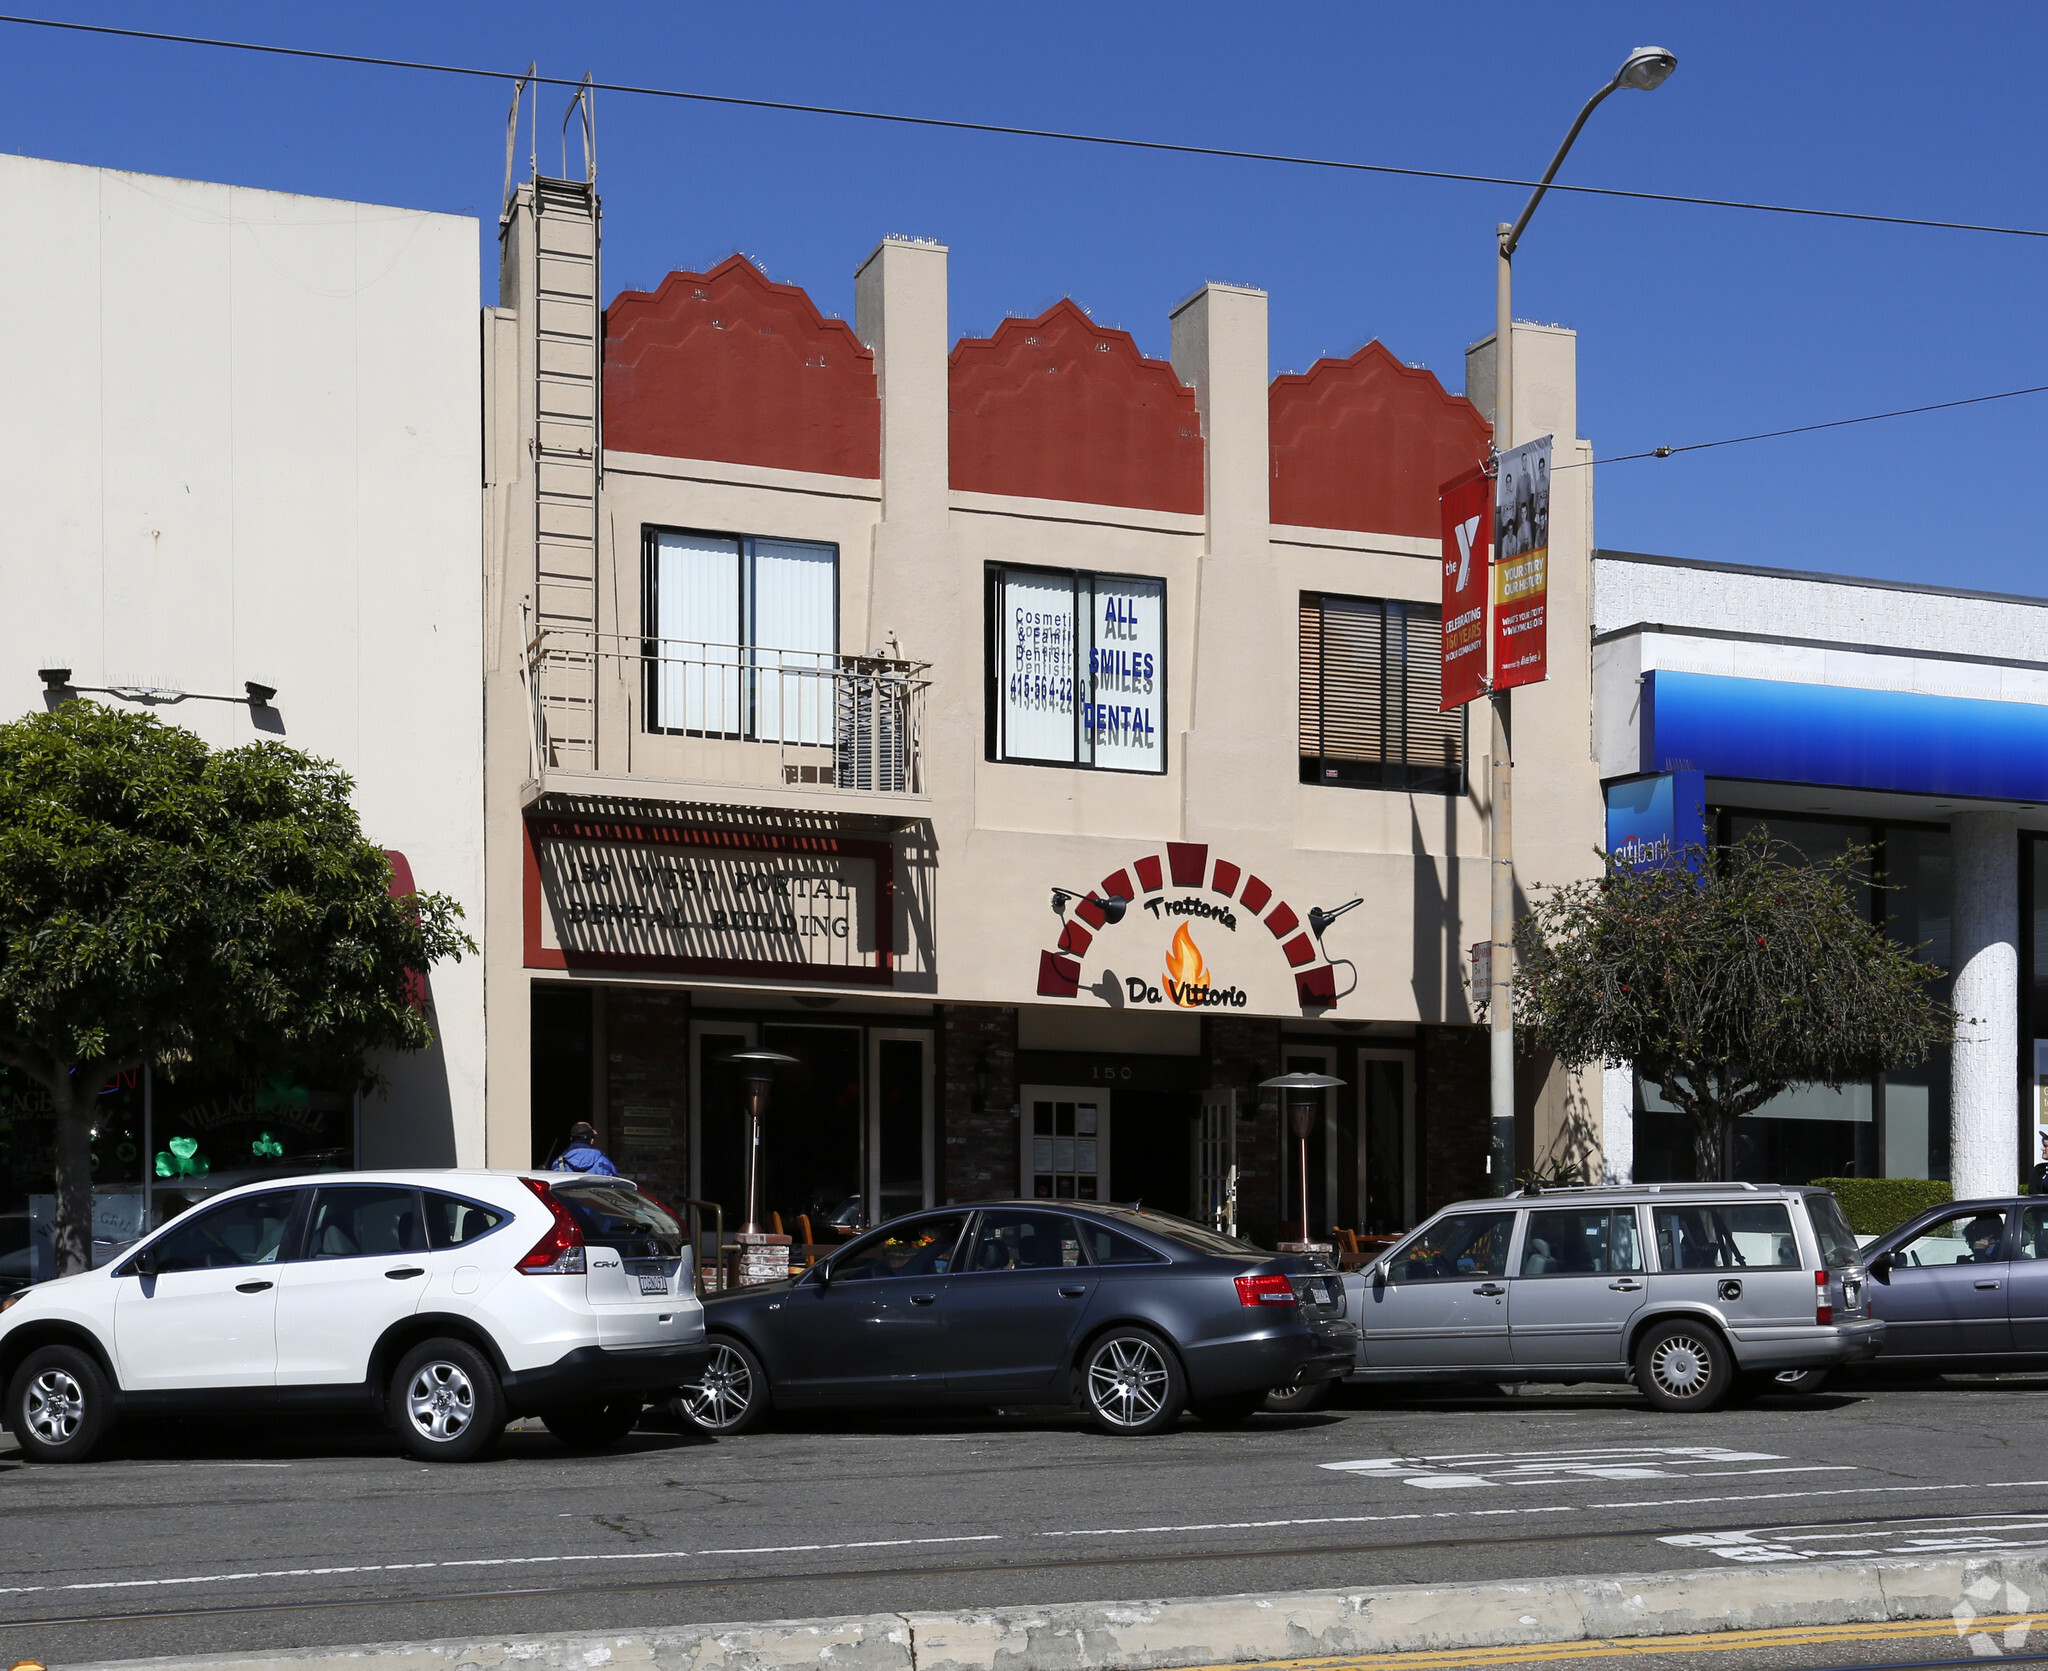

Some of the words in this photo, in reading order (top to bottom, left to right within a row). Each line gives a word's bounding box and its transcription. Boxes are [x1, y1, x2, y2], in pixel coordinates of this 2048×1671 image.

[1446, 560, 1457, 576] the
[1504, 565, 1523, 581] YOUR
[1504, 580, 1518, 595] OUR
[1016, 607, 1072, 627] Cosmeti
[1105, 597, 1138, 624] ALL
[1446, 606, 1481, 634] CELEBRATING
[1018, 626, 1025, 641] &
[1033, 627, 1074, 647] Famil
[1459, 621, 1481, 644] YEARS
[1016, 645, 1072, 664] Dentistr
[1458, 639, 1482, 657] COMMUNITY
[1089, 648, 1154, 679] SMILES
[1010, 672, 1086, 702] 415-564-220
[1084, 702, 1155, 733] DENTAL
[1614, 833, 1670, 867] citibank
[568, 862, 611, 885] 156
[631, 866, 715, 892] WEST
[735, 872, 850, 900] PORTAL
[568, 901, 688, 928] DENTAL
[712, 909, 850, 938] BUILDING
[1143, 896, 1237, 933] Trattoria
[1125, 976, 1163, 1004] Da
[1168, 979, 1247, 1008] Vittorio
[1092, 1066, 1132, 1080] 150
